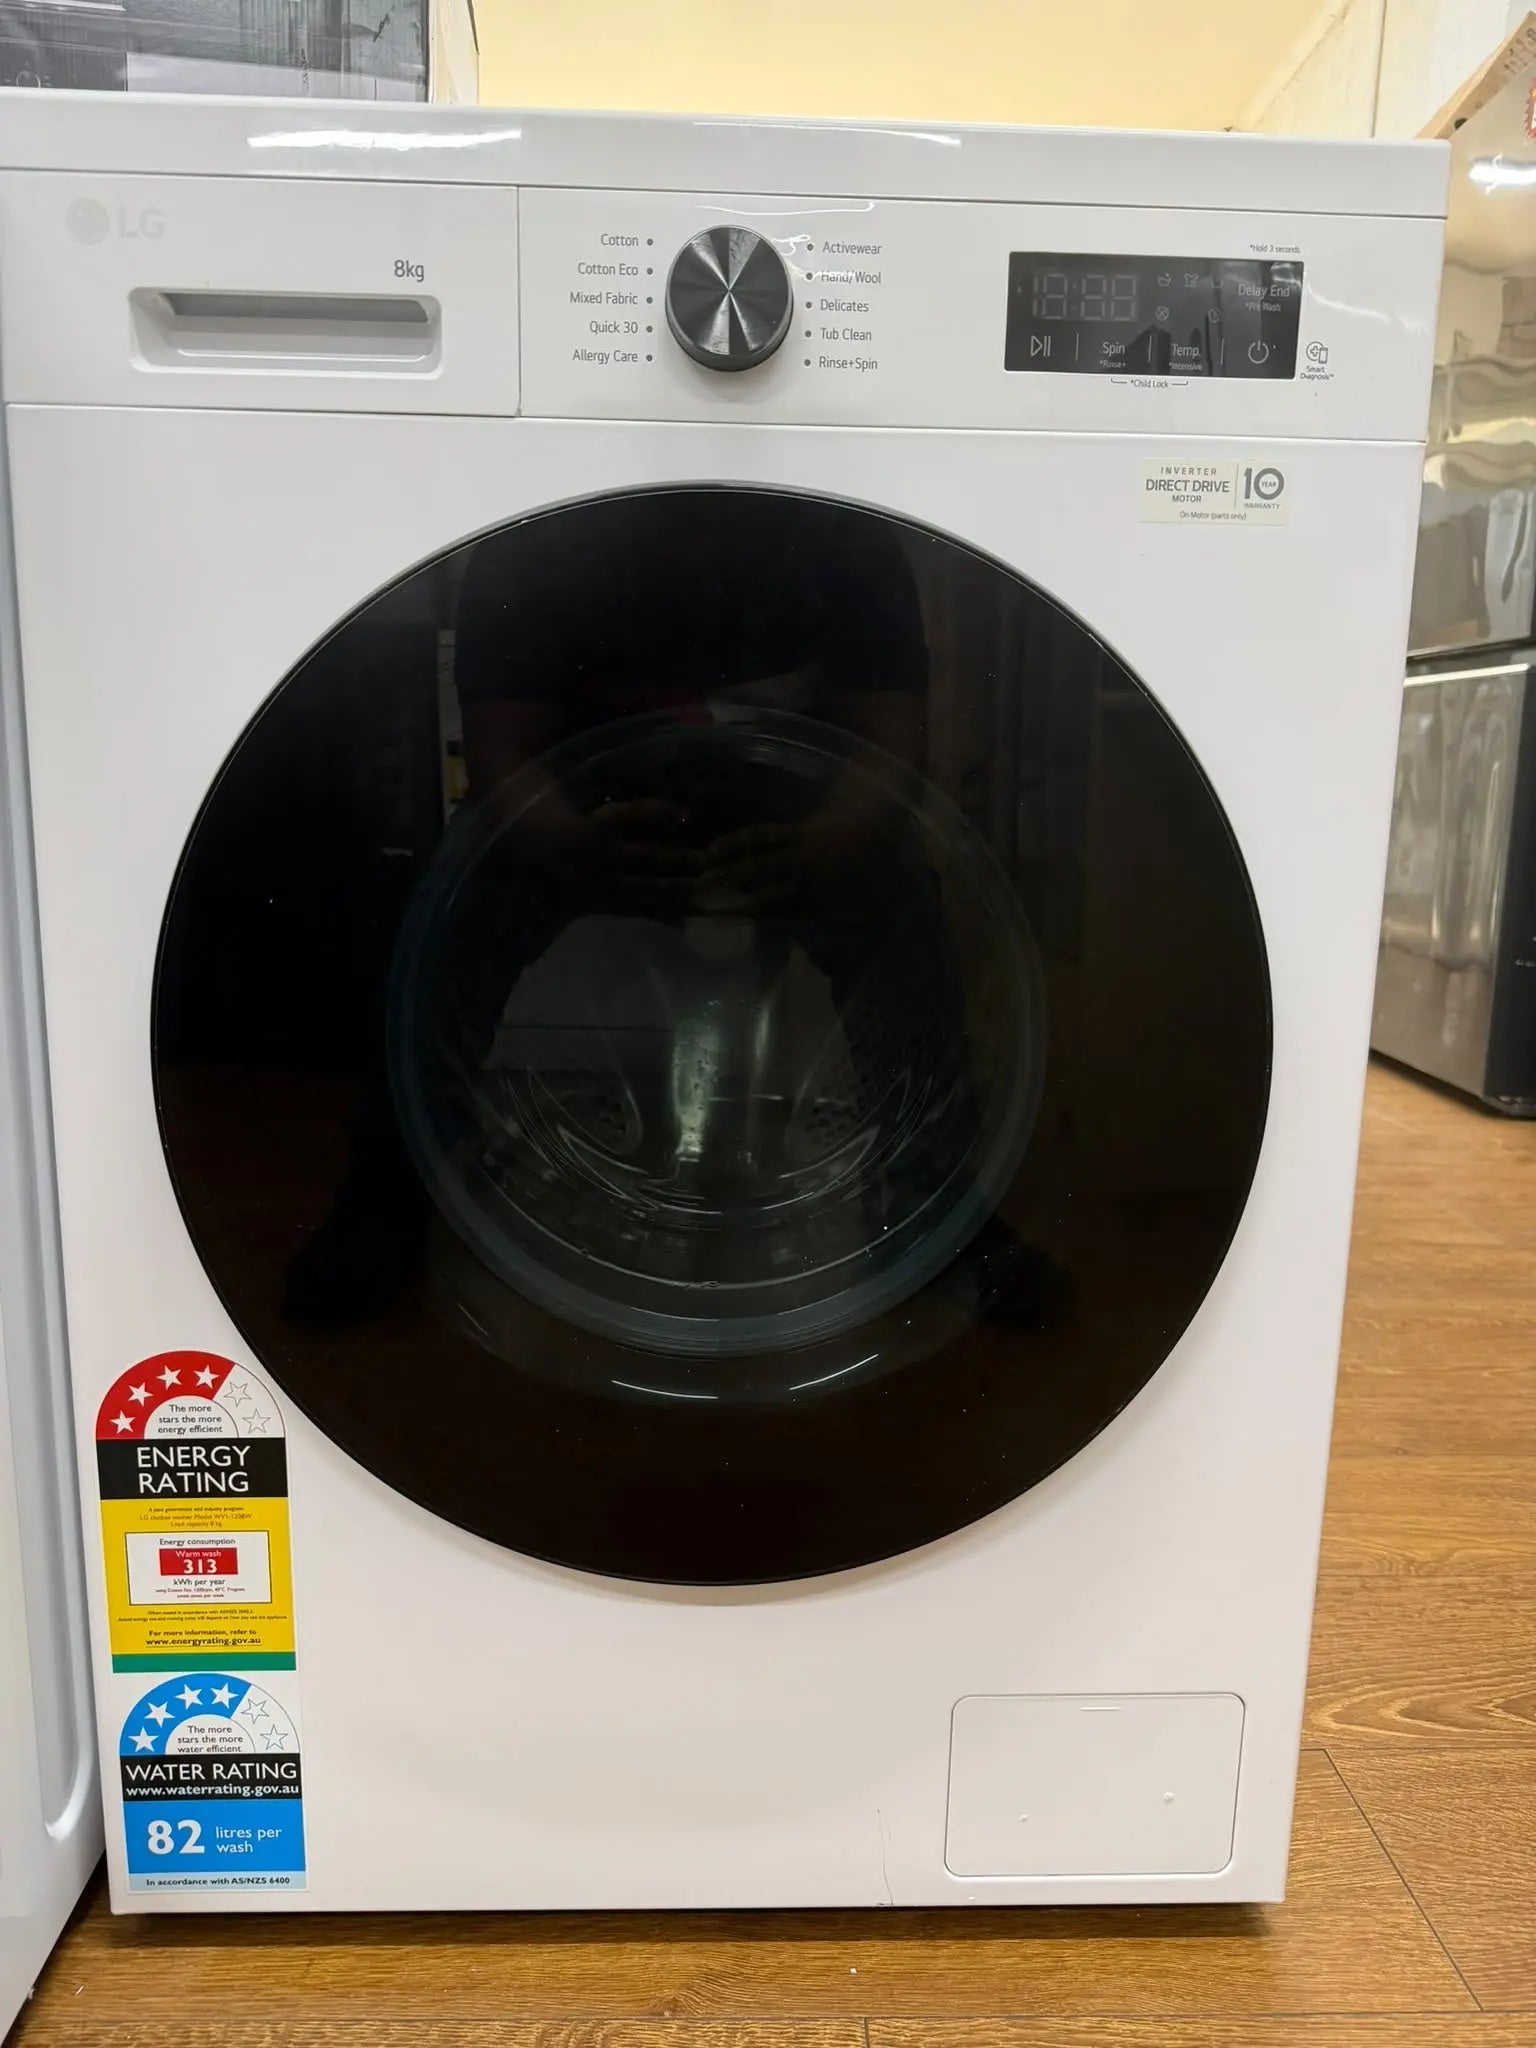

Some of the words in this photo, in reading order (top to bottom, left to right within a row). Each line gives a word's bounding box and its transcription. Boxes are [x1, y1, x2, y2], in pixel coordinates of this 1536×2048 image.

[117, 206, 165, 239] LG
[600, 233, 640, 247] Cotton
[822, 241, 883, 255] Activewear
[1268, 245, 1274, 253] 3
[1276, 246, 1300, 254] seconds
[394, 259, 424, 282] 8kg
[578, 262, 616, 276] Cotton
[618, 264, 640, 276] Eco
[569, 291, 602, 304] Mixed
[606, 292, 639, 304] Fabric
[1238, 283, 1268, 300] Delay
[1270, 284, 1290, 298] End
[820, 298, 870, 313] Delicates
[1262, 302, 1282, 312] Wash
[589, 320, 620, 334] Quick
[623, 321, 639, 334] 30
[820, 328, 839, 341] Tub
[842, 328, 872, 342] Clean
[1102, 341, 1126, 357] Spin
[1172, 343, 1201, 359] Temp.
[572, 348, 610, 365] Allergy
[612, 350, 639, 363] Care
[818, 356, 879, 371] Rinse+Spin
[1152, 380, 1169, 388] Lock
[1160, 466, 1218, 476] INVERTER
[1145, 478, 1190, 492] DIRECT
[1192, 480, 1230, 493] DRIVE
[1244, 467, 1285, 500] 10
[1172, 494, 1202, 503] MOTOR
[1180, 510, 1190, 519] On
[1190, 511, 1210, 520] Motor
[168, 1404, 187, 1413] The
[181, 1416, 196, 1424] the
[158, 1426, 186, 1435] energy
[189, 1425, 223, 1434] efficient
[136, 1445, 251, 1468] ENERGY
[138, 1471, 249, 1494] RATING
[159, 1538, 185, 1546] Energy
[186, 1538, 236, 1546] consumption
[176, 1550, 200, 1558] Warm
[202, 1550, 222, 1558] wash
[183, 1558, 218, 1574] 313
[194, 1578, 208, 1586] per
[209, 1578, 226, 1586] year
[184, 1629, 228, 1638] information,
[146, 1636, 262, 1646] www.energyrating.gov.au
[187, 1726, 206, 1734] The
[202, 1735, 217, 1743] the
[206, 1744, 242, 1753] efficient
[125, 1764, 206, 1781] WATER
[212, 1762, 297, 1780] RATING
[126, 1783, 300, 1797] www.waterrating.gov.au
[147, 1818, 206, 1856] 82
[215, 1826, 252, 1839] litres
[257, 1827, 282, 1842] per
[216, 1841, 254, 1854] wash
[156, 1878, 208, 1886] accordance
[210, 1878, 230, 1886] with
[230, 1877, 268, 1886] AS/NZS
[268, 1876, 290, 1885] 6400
